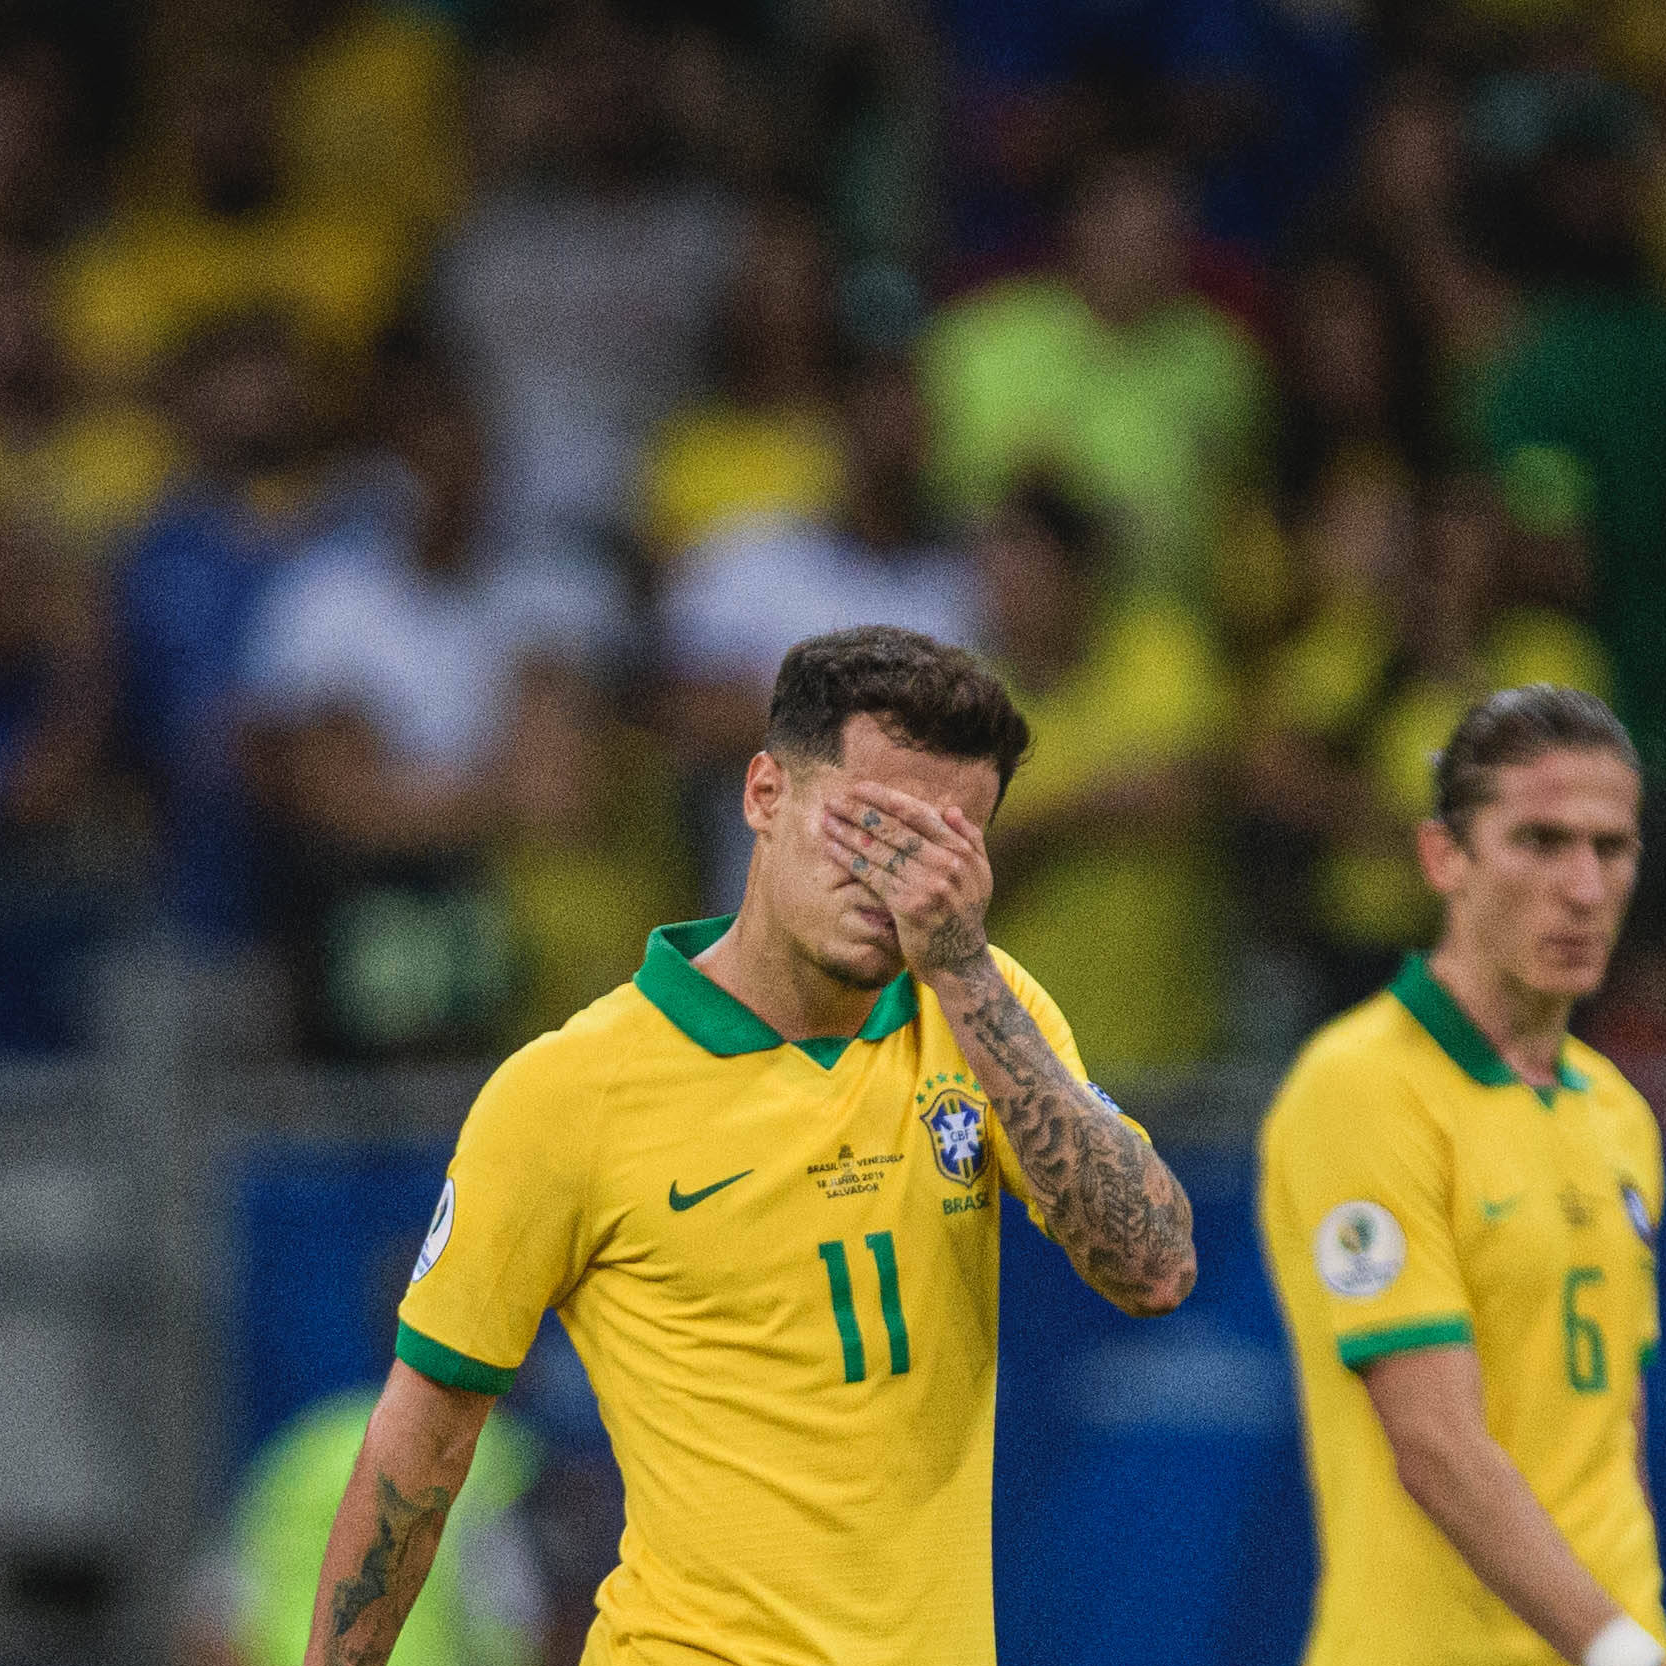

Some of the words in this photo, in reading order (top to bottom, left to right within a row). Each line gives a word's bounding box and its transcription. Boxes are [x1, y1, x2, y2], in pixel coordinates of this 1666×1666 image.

[950, 1129, 971, 1142] CBF
[807, 1162, 839, 1174] BRASIL
[856, 1152, 906, 1167] VENEZUELA
[825, 1182, 880, 1199] SALVADOR
[942, 1191, 988, 1217] BRAS
[818, 1230, 910, 1383] 11
[1562, 1265, 1608, 1393] 6
